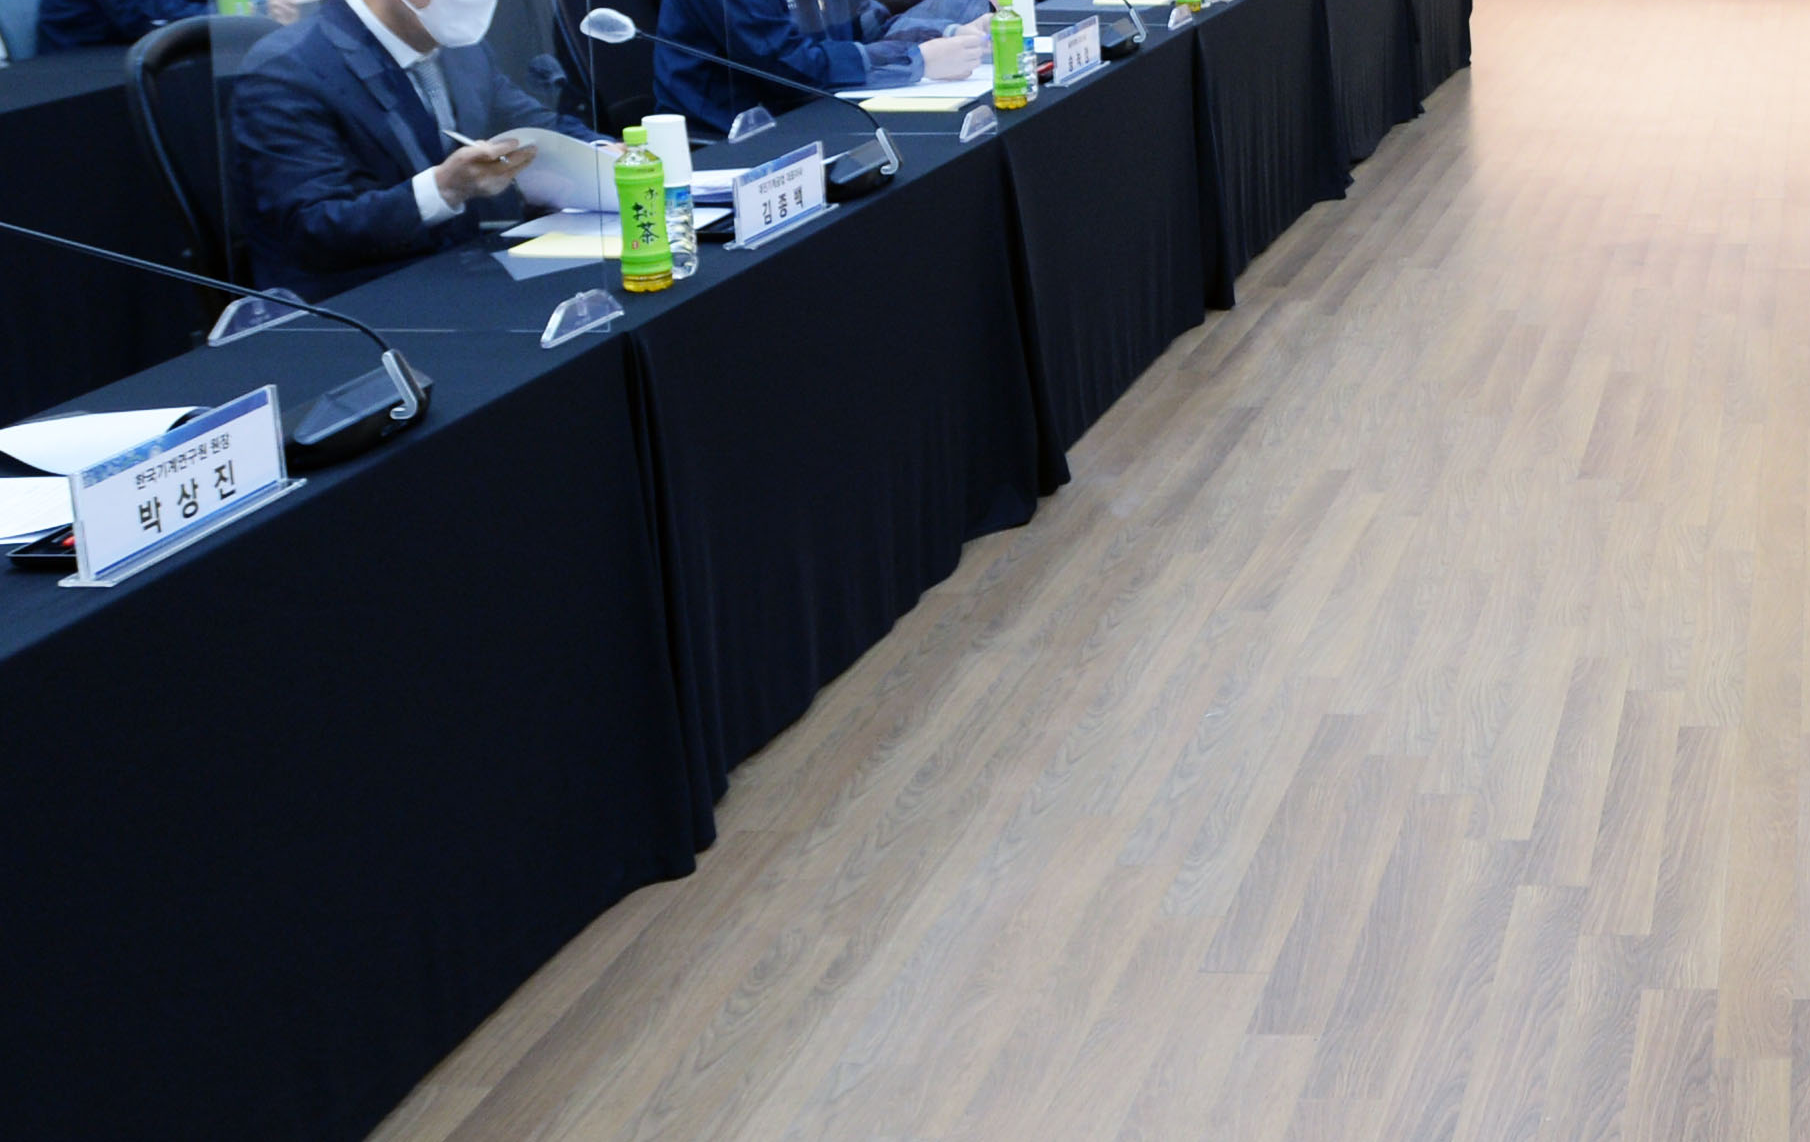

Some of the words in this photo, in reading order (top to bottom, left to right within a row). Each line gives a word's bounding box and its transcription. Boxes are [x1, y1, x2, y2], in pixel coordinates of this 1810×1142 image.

[134, 443, 208, 491] 한국기계연구원
[209, 433, 231, 455] 원장
[137, 459, 237, 534] 박상진
